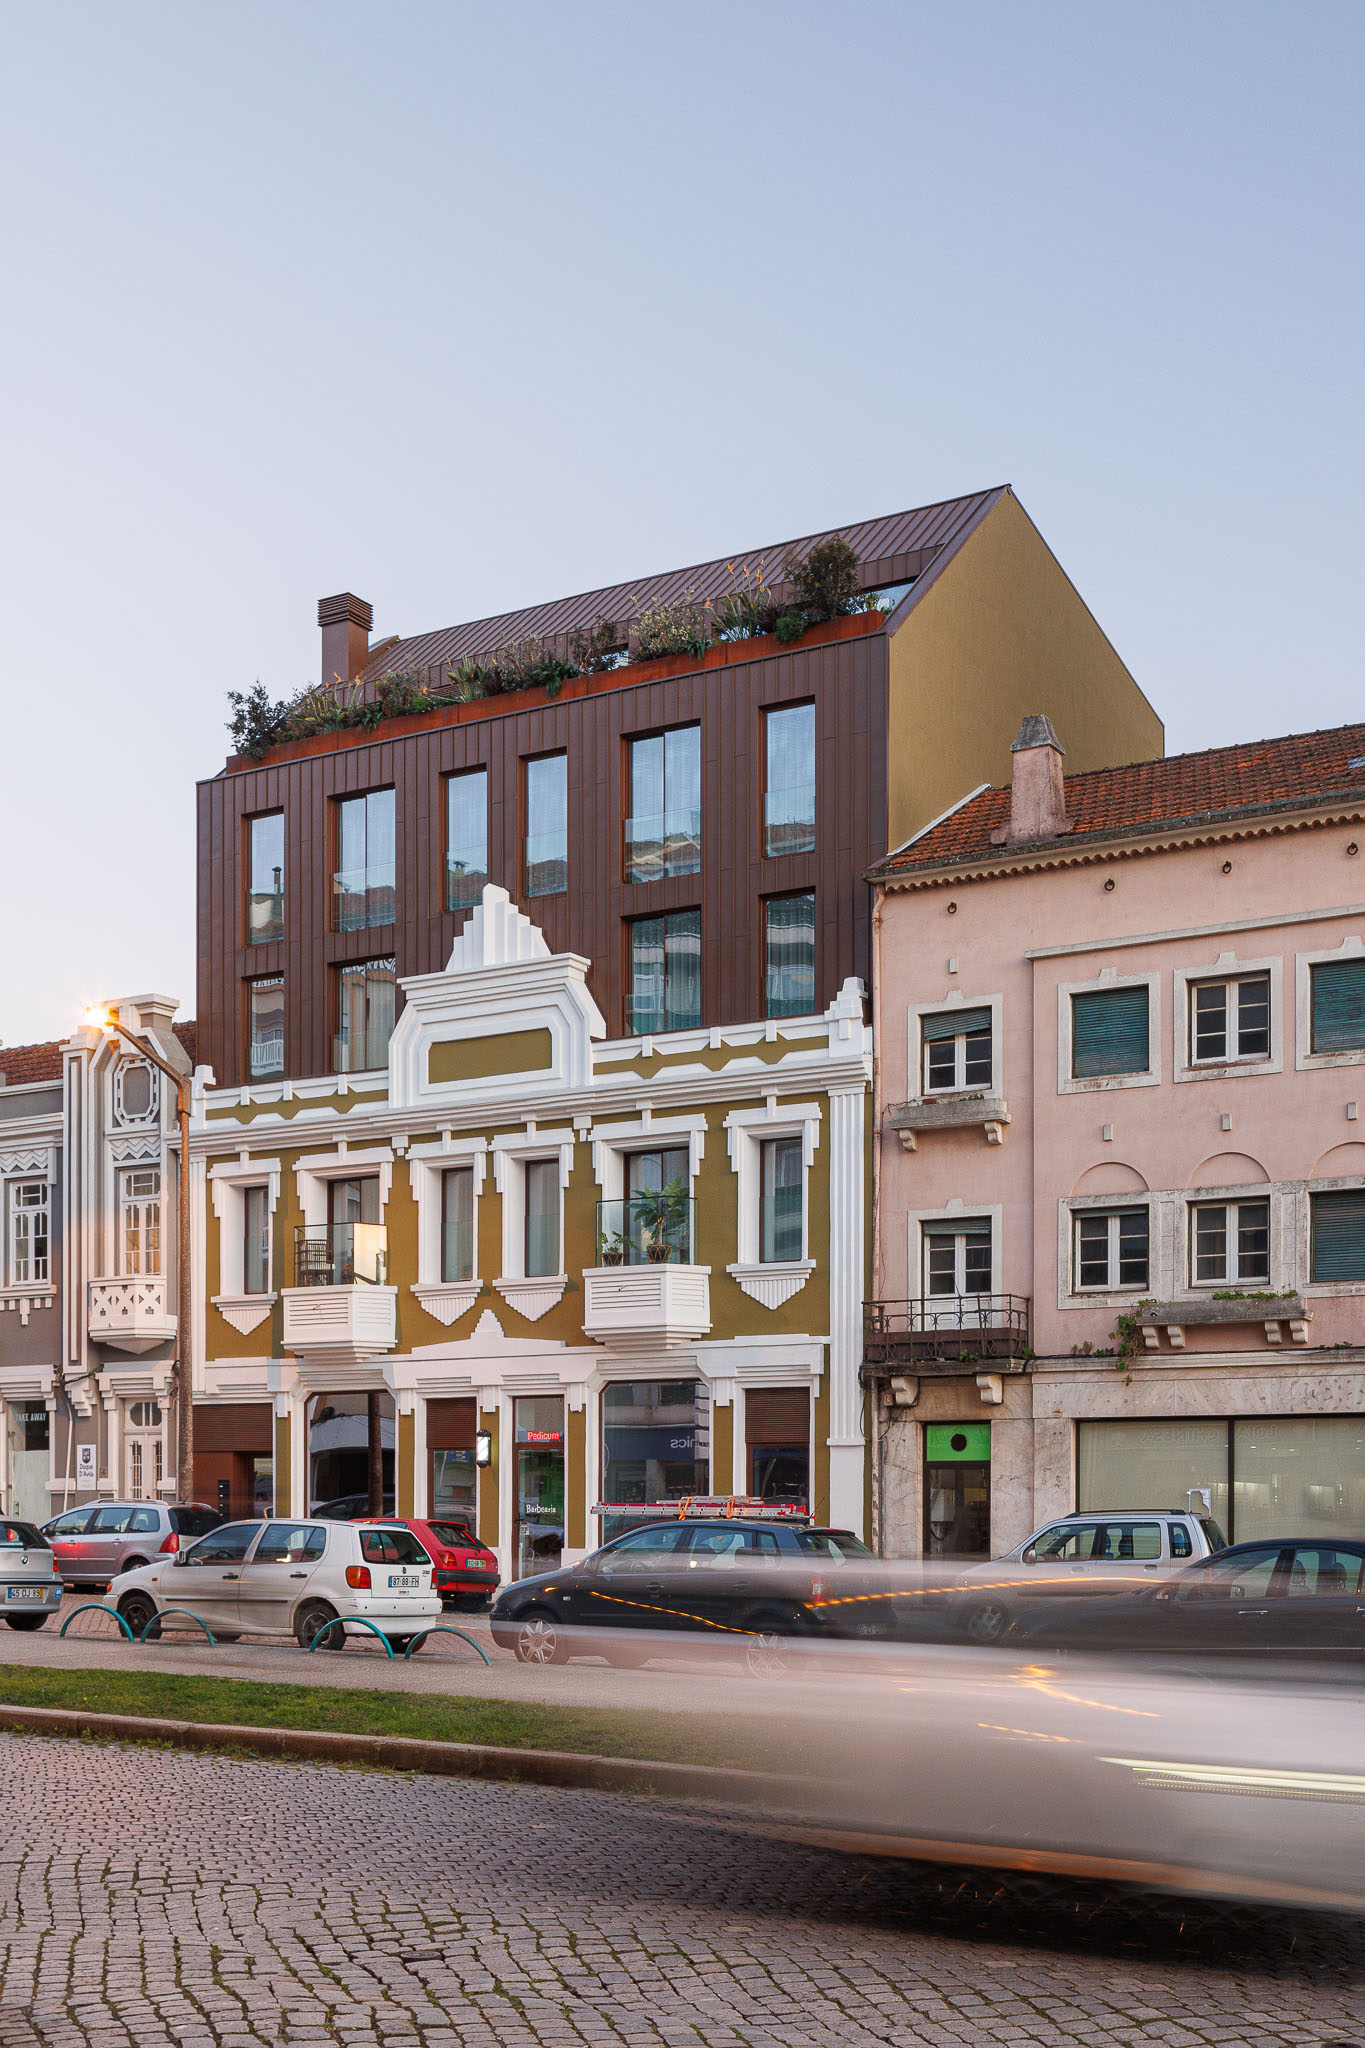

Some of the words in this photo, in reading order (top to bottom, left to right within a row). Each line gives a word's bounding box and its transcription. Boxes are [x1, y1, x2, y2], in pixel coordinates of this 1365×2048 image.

[16, 1413, 29, 1421] TAKE
[30, 1412, 47, 1421] AWAY
[527, 1431, 560, 1440] Pedicure
[526, 1504, 556, 1514] Barbearia
